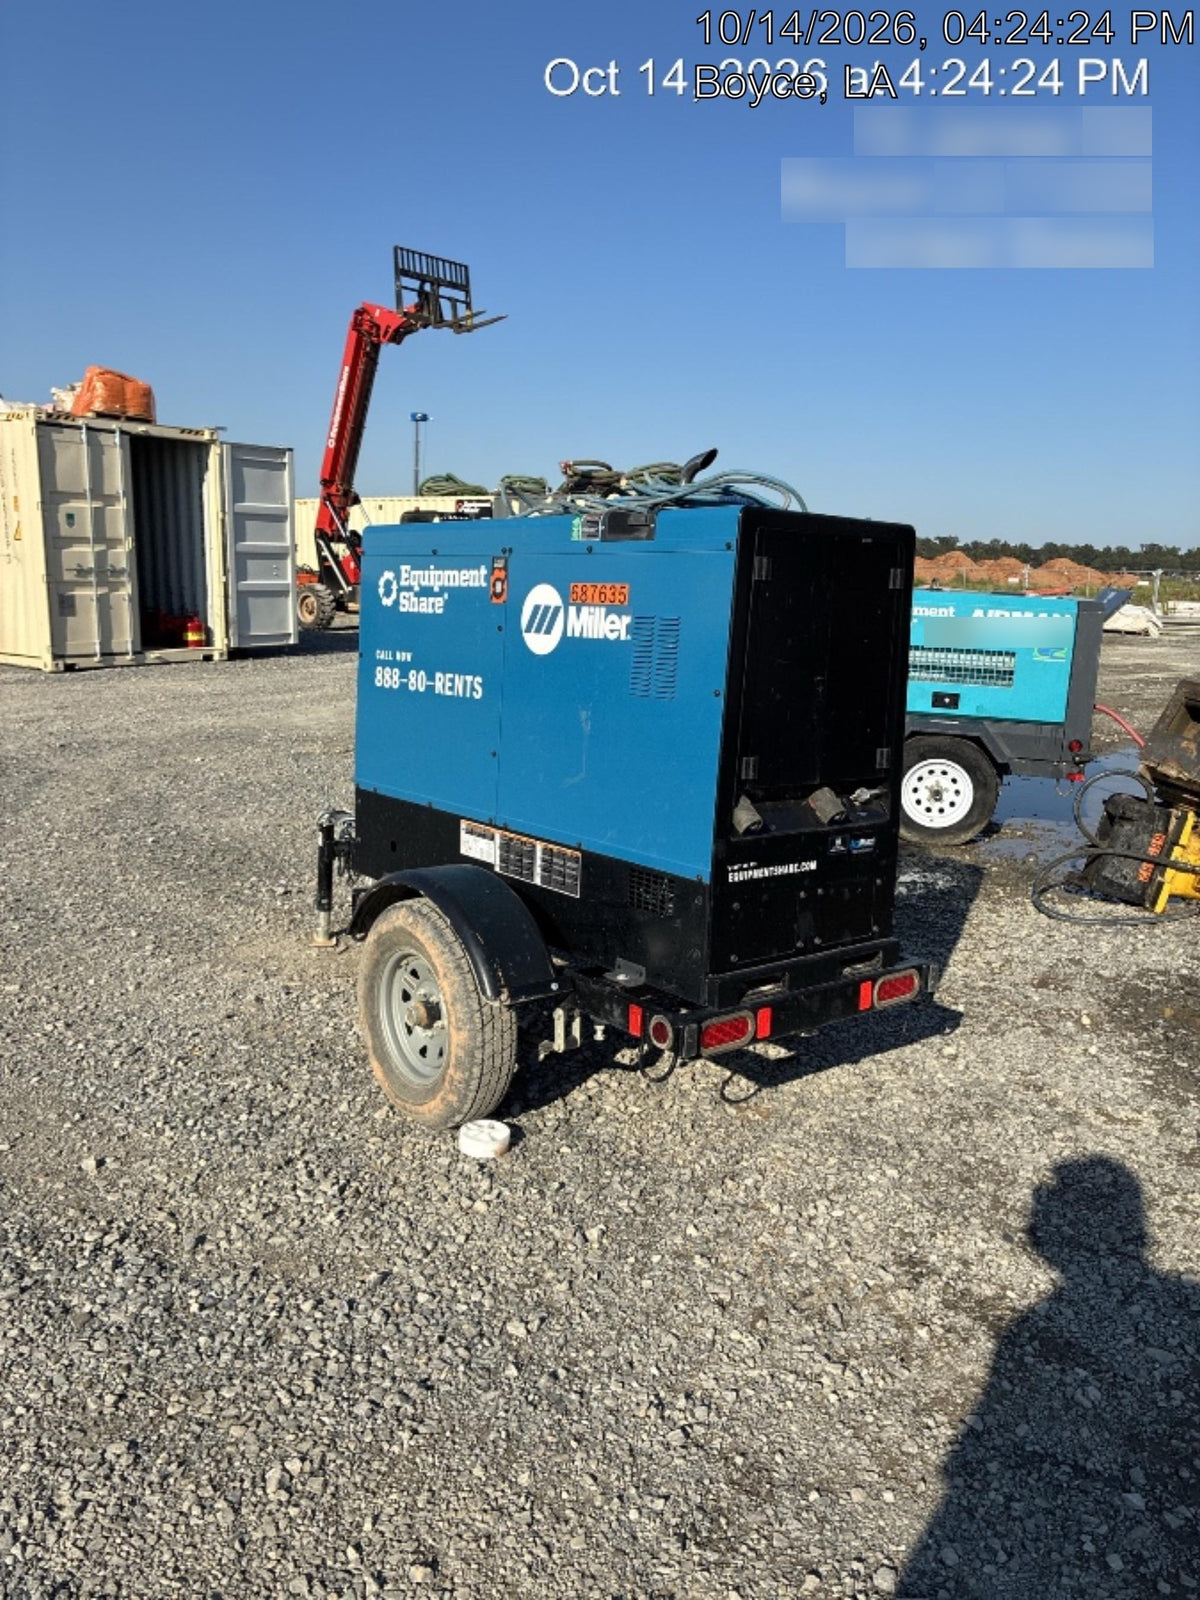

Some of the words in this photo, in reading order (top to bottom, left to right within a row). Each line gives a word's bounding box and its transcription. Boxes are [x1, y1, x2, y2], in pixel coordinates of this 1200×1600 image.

[399, 564, 488, 591] Equipment
[399, 589, 443, 613] Share
[375, 649, 394, 661] CALL
[374, 667, 483, 699] 888-80-RENTS
